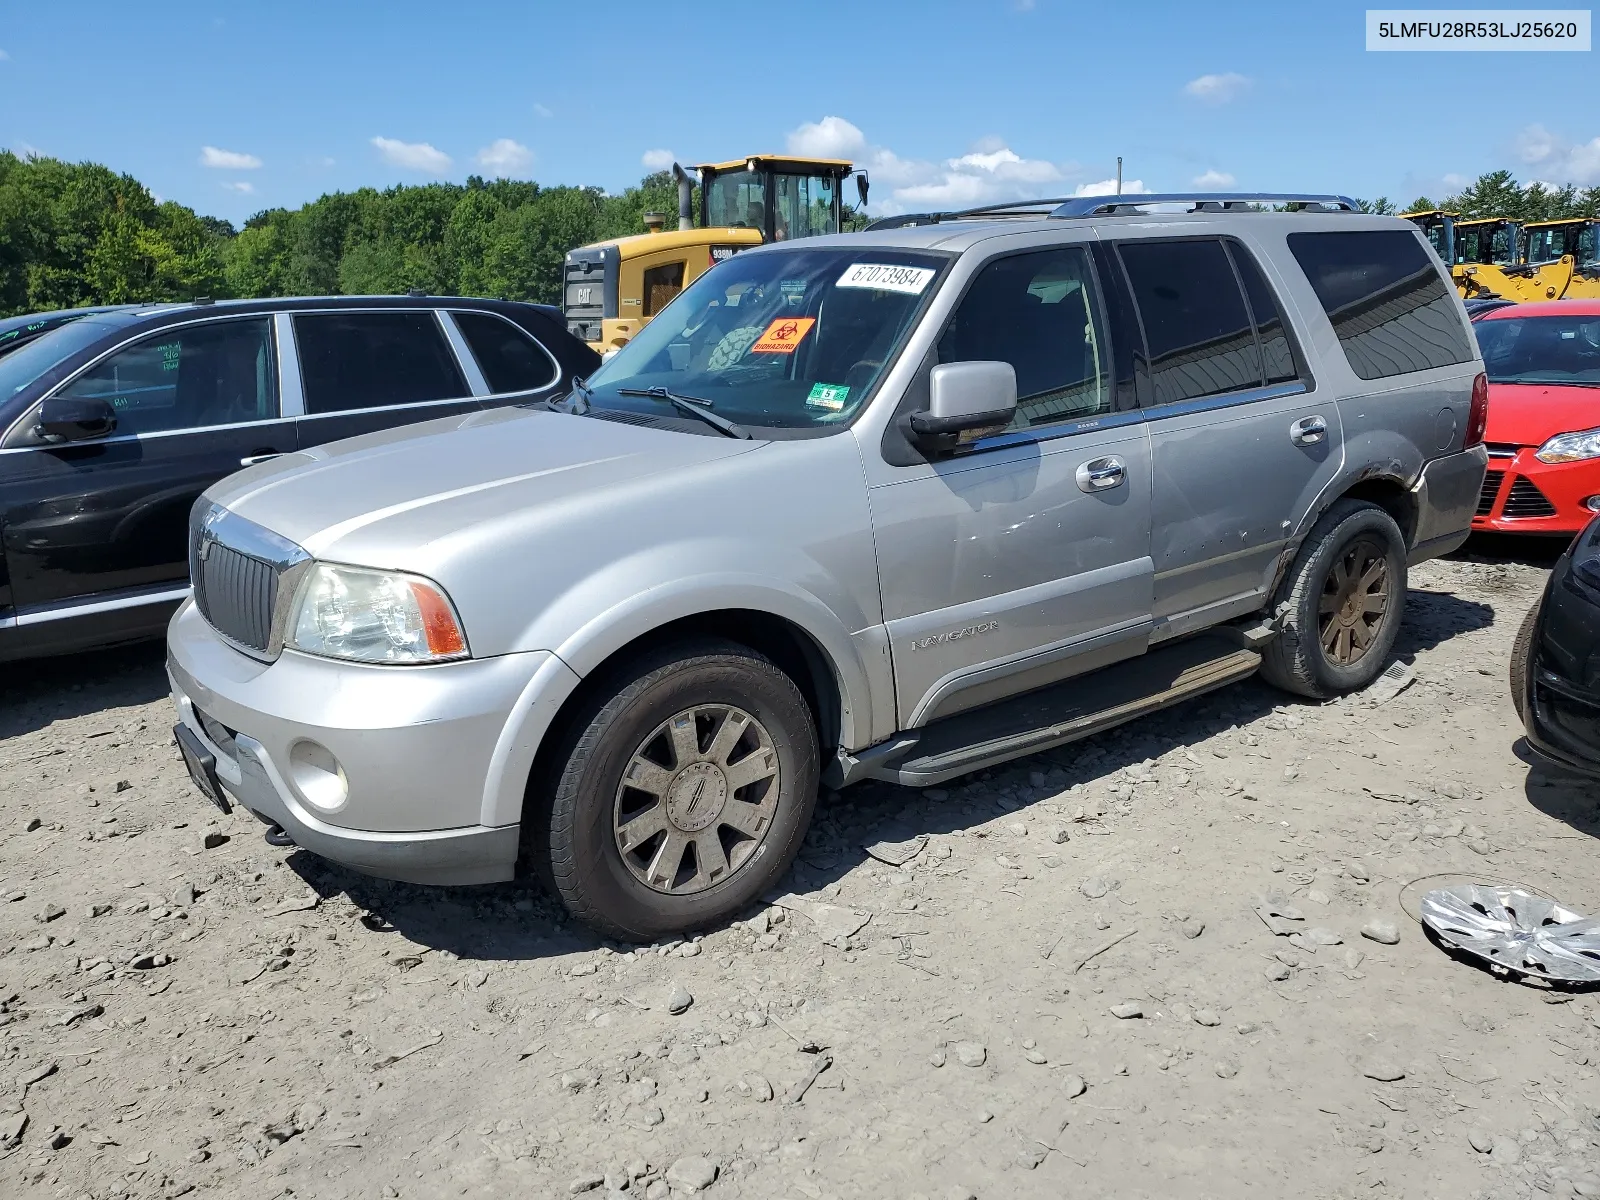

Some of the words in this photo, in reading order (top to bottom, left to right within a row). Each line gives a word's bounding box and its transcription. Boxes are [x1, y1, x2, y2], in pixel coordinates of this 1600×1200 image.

[852, 266, 922, 286] 67073984
[578, 288, 592, 304] CAT
[824, 390, 832, 398] 5
[911, 620, 998, 652] NAVIGATOR
